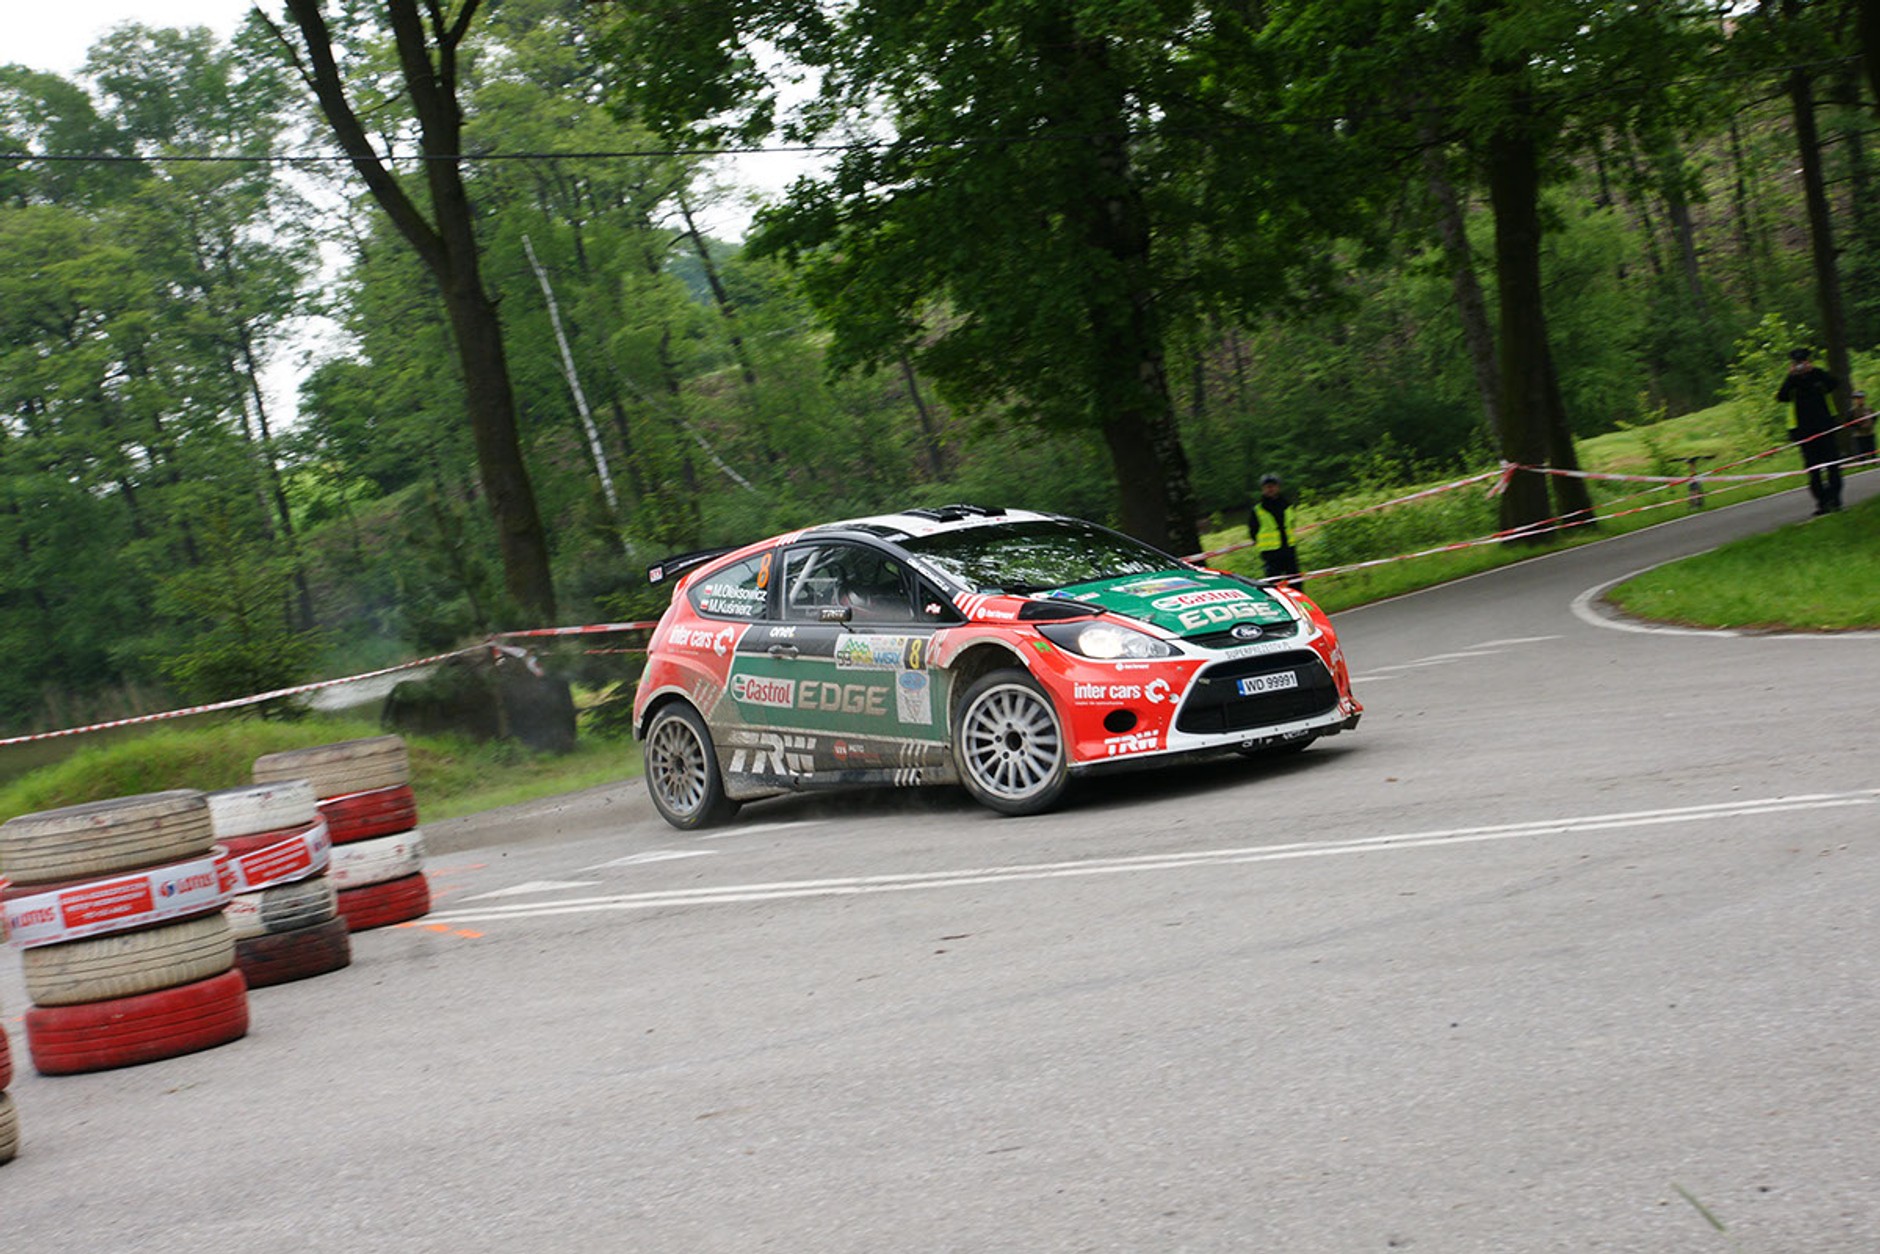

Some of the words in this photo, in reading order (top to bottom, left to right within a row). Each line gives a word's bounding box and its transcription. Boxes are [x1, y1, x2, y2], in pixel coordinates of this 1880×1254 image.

[757, 553, 772, 589] 8
[1178, 589, 1246, 606] Castrol
[1178, 602, 1280, 630] EDGE
[668, 624, 691, 645] inter
[690, 630, 714, 648] cars
[909, 639, 923, 669] 8
[745, 678, 791, 705] Castrol
[1074, 682, 1107, 699] inter
[1109, 684, 1142, 699] cars
[1245, 678, 1265, 692] WD
[1266, 674, 1297, 689] 99991
[797, 680, 890, 716] EDGE
[728, 731, 817, 777] TRW
[1104, 729, 1159, 756] TRW
